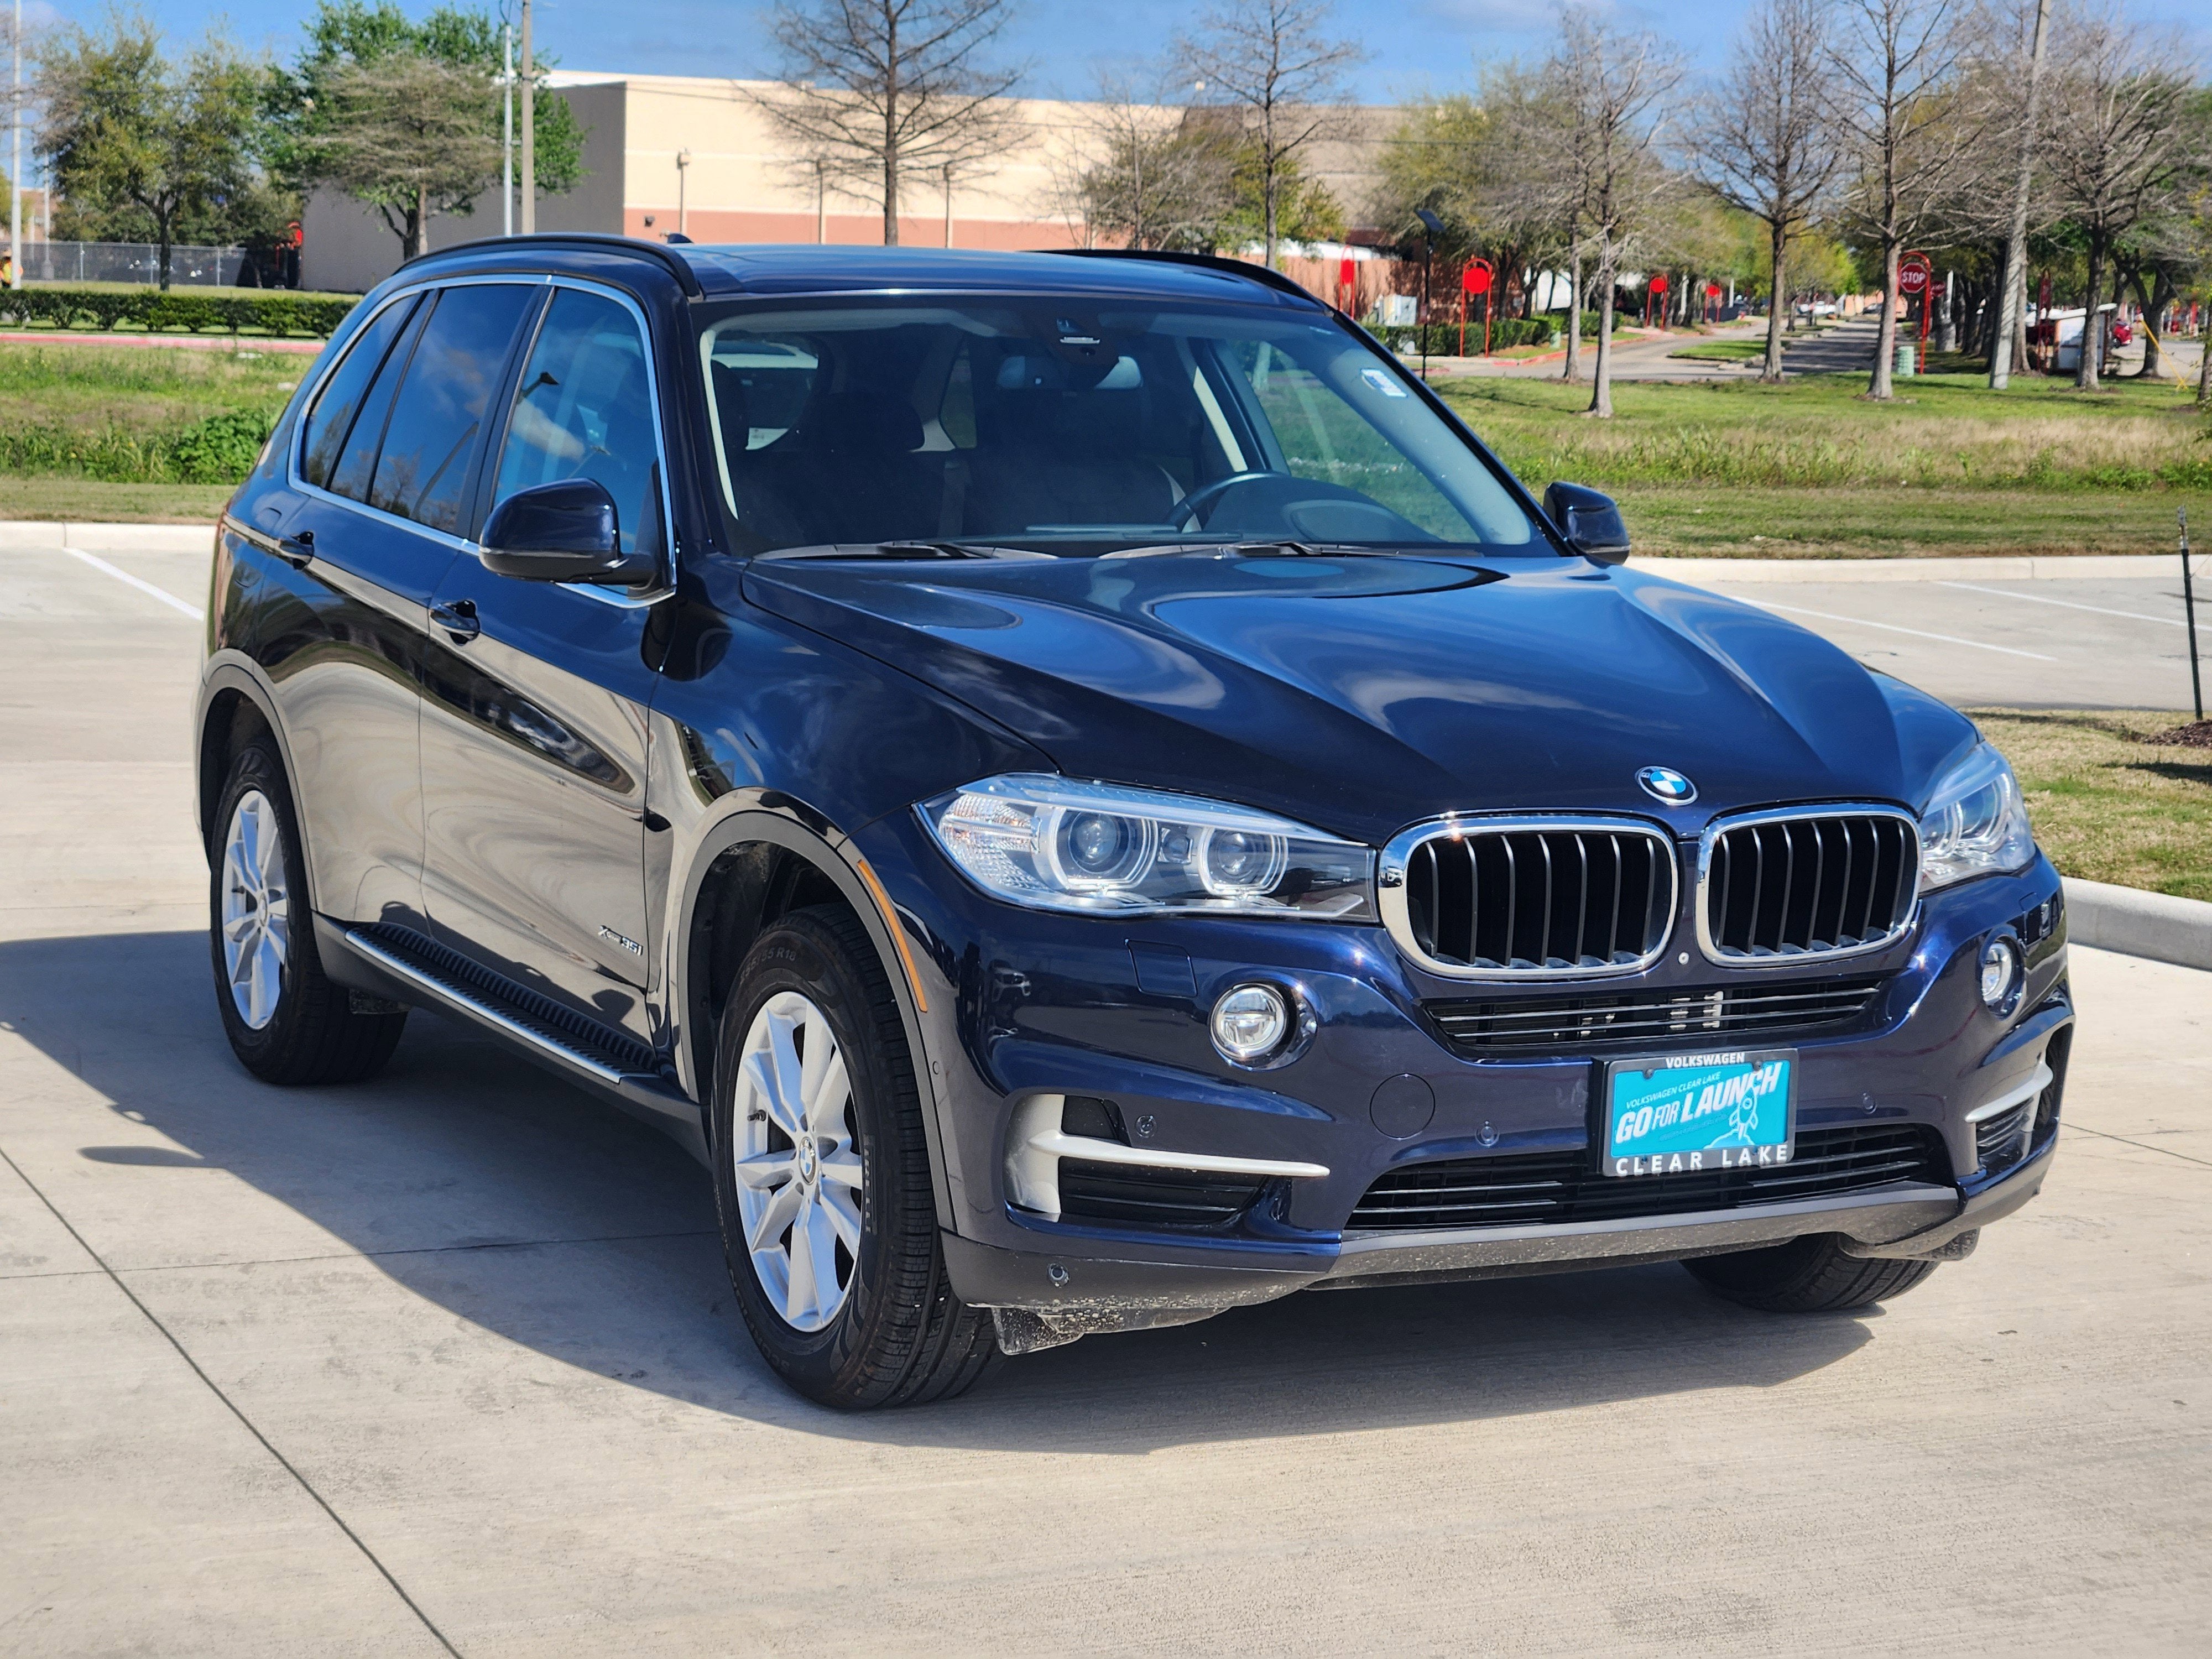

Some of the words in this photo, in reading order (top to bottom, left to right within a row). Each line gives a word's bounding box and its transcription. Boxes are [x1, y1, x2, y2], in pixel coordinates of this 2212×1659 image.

[1902, 271, 1926, 284] STOP
[1666, 1053, 1745, 1068] VOLKSWAGEN
[1615, 1106, 1653, 1144] GO
[1652, 1100, 1681, 1130] FOR
[1679, 1062, 1783, 1124] LAUNCH
[1626, 1086, 1678, 1109] VOLKSWAGEN
[1678, 1078, 1702, 1093] CLEAR
[1702, 1071, 1721, 1085] LAKE
[1615, 1152, 1703, 1176] CLEAR
[1721, 1144, 1788, 1168] LAKE
